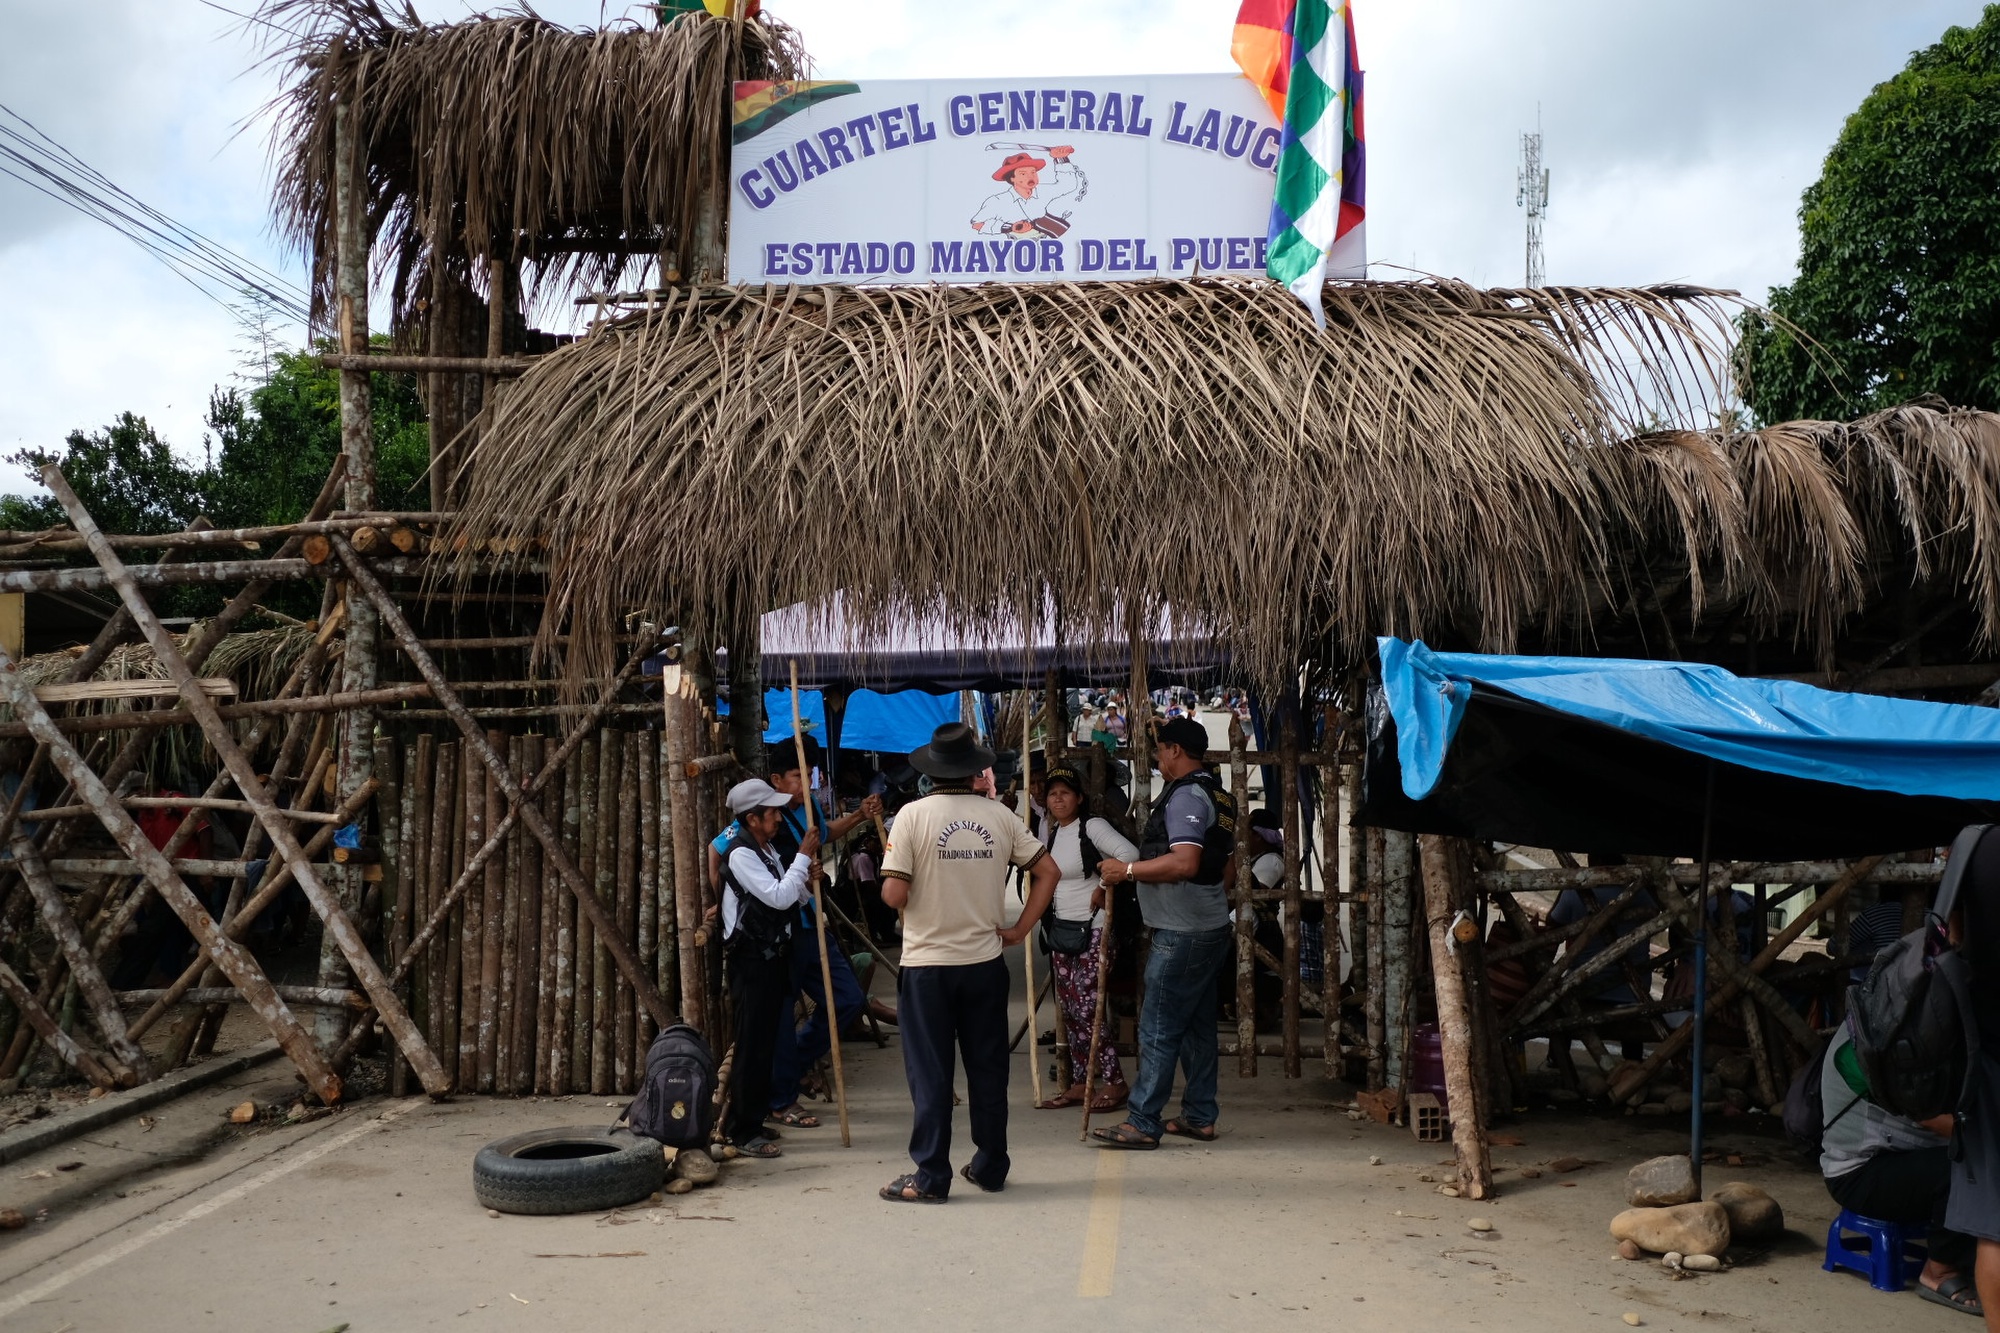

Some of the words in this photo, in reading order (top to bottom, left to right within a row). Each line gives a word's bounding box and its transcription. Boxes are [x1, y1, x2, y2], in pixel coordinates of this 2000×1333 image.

[739, 103, 937, 210] CUARTEL
[950, 89, 1153, 137] GENERAL
[1166, 100, 1282, 172] LAUC
[765, 241, 916, 276] ESTADO
[930, 239, 1065, 274] MAYOR
[1079, 238, 1158, 272] DEL
[937, 820, 961, 848] LEALES
[961, 820, 995, 847] SIEMPRE
[937, 849, 973, 860] TRAIDORES
[973, 849, 994, 859] NUNCA
